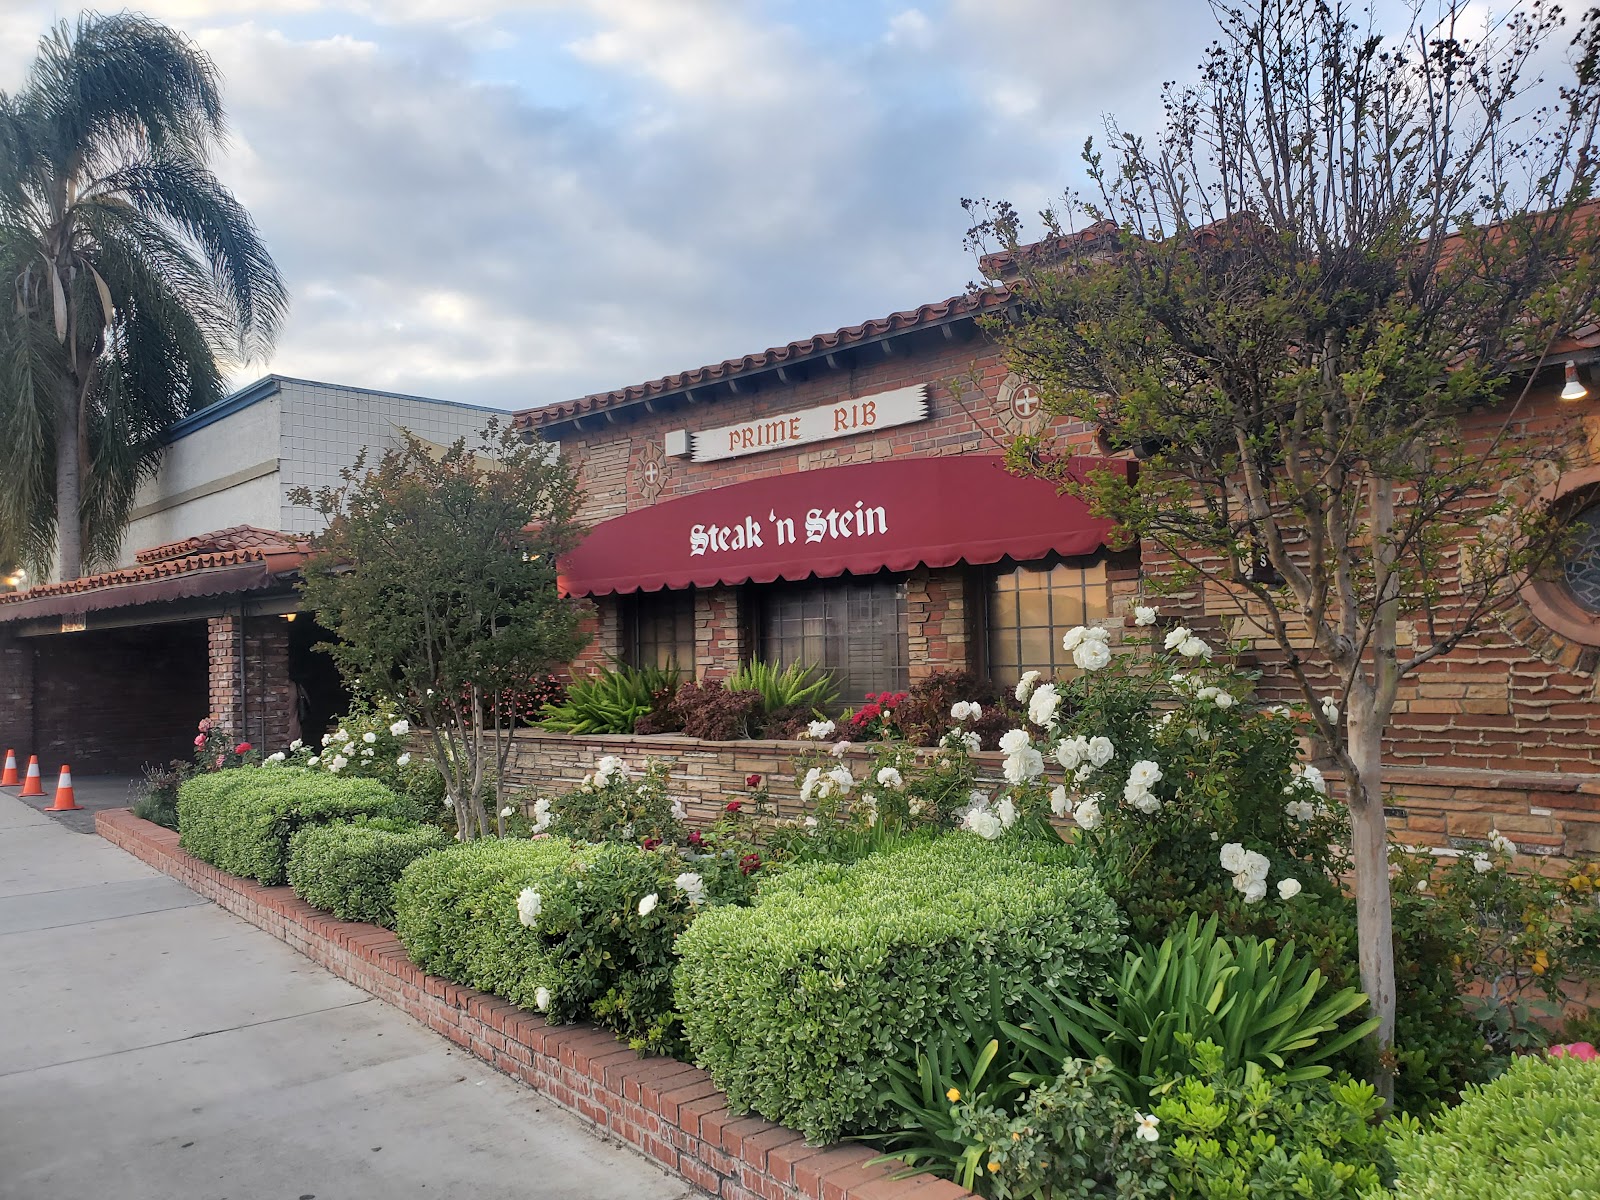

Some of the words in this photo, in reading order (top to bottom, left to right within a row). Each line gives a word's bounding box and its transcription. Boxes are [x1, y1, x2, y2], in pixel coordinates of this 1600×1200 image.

[729, 417, 802, 452] PRIME
[833, 400, 877, 432] RIB
[689, 515, 764, 557] Steak
[805, 500, 889, 545] Stein
